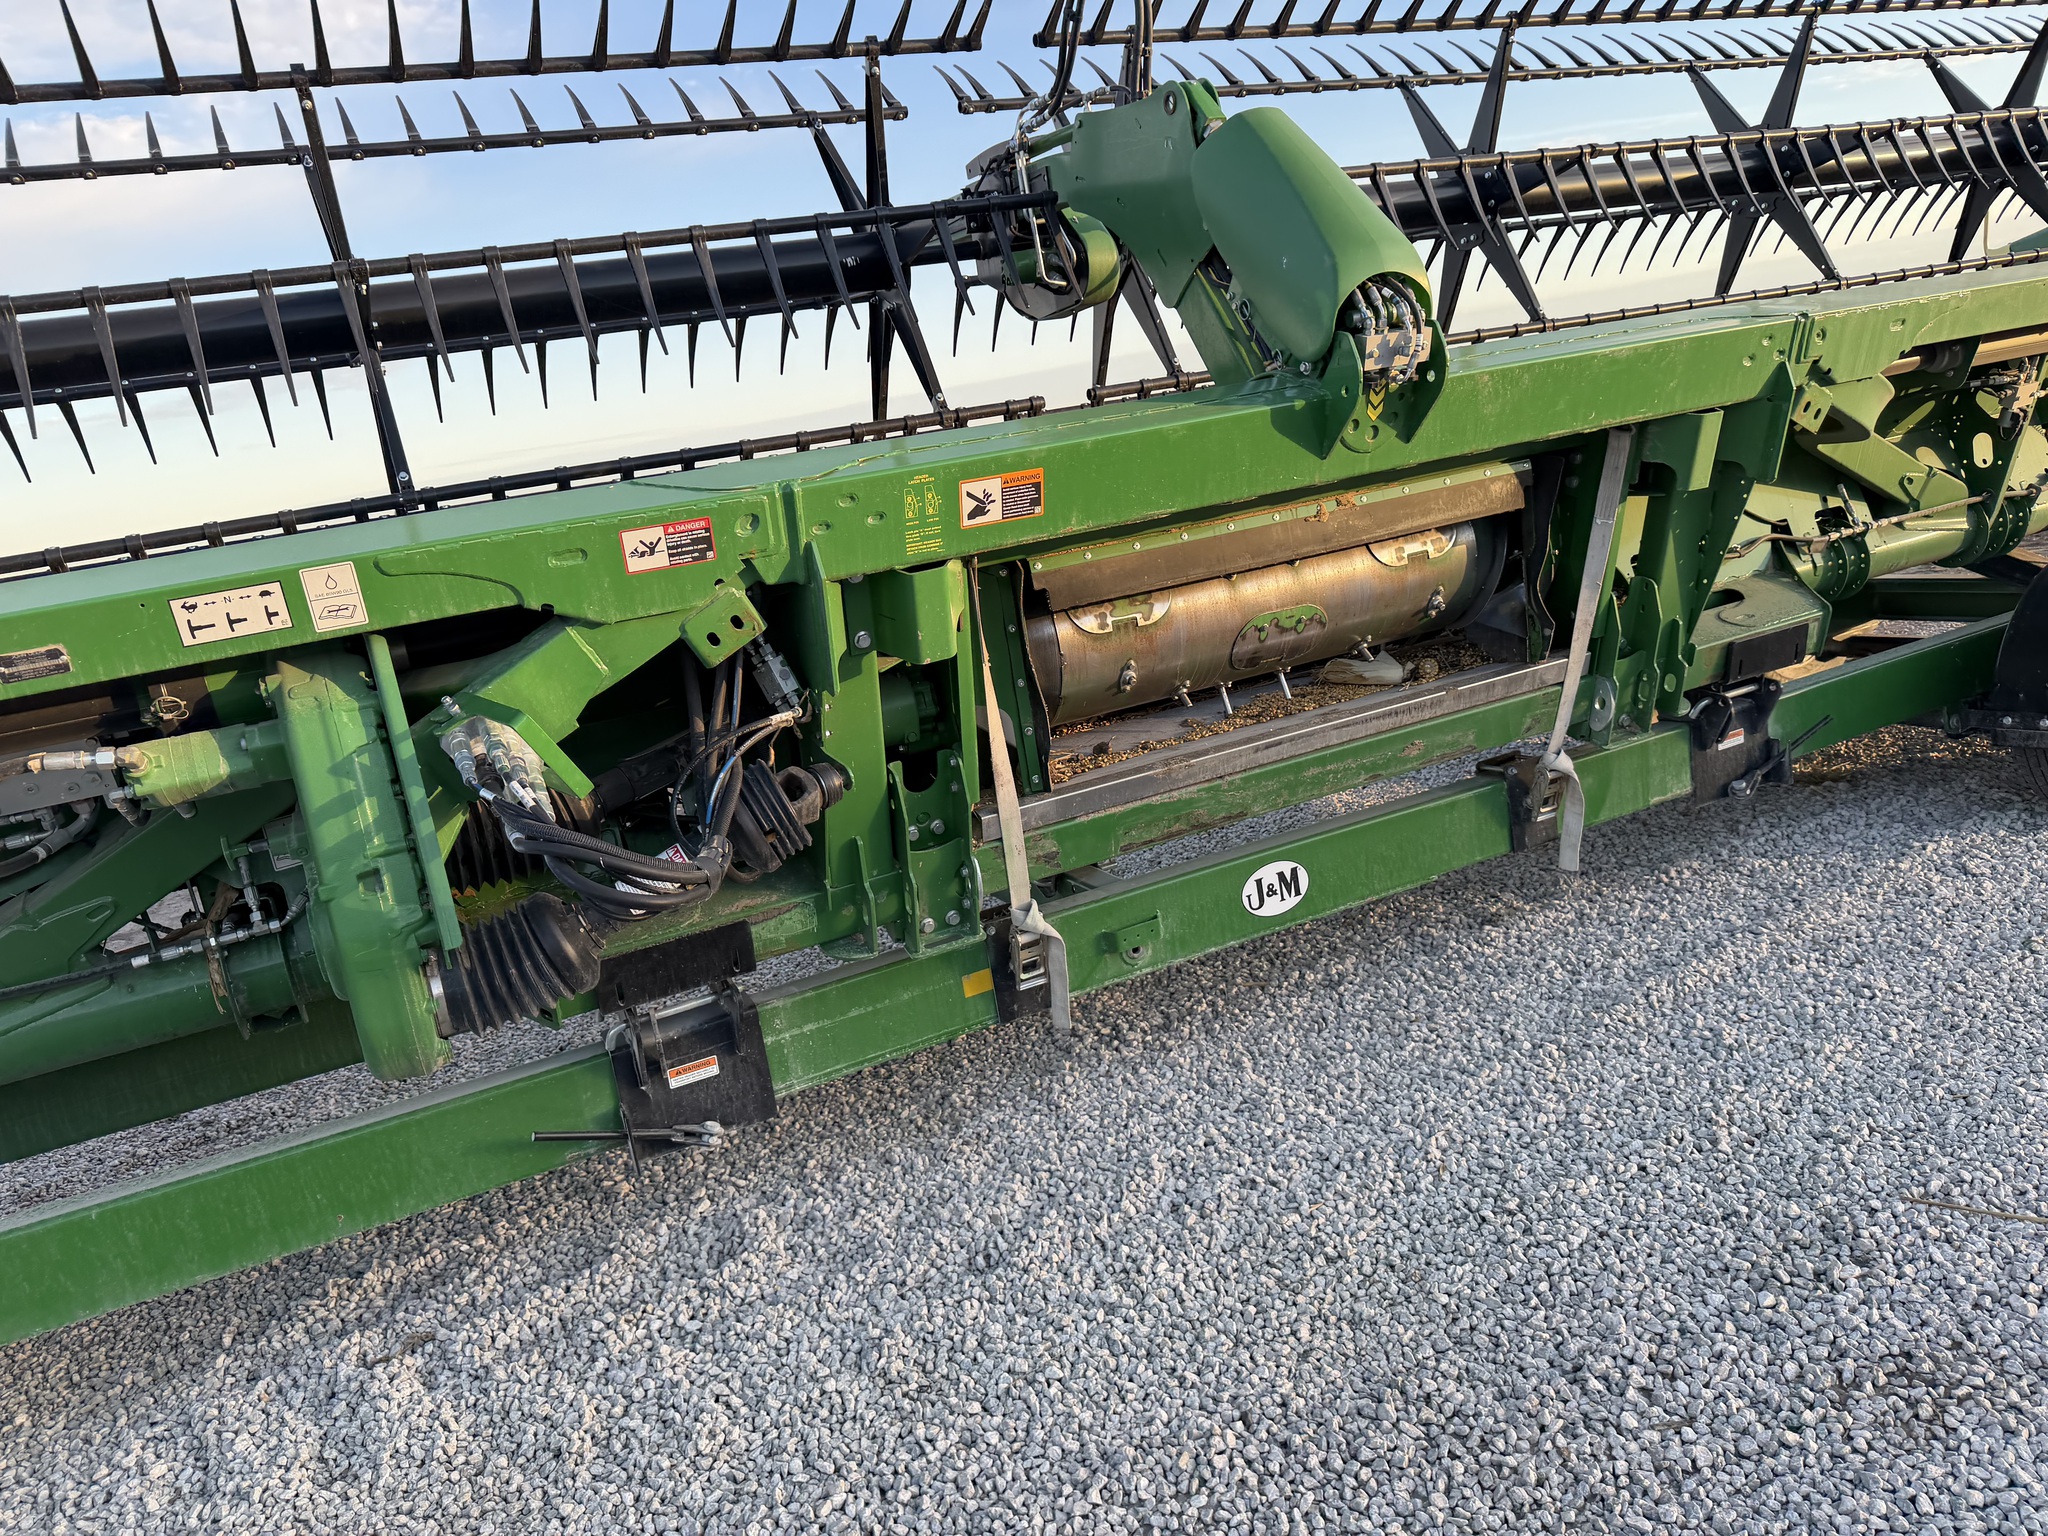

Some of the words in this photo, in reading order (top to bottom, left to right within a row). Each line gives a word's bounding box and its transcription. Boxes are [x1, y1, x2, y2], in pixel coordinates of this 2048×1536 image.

[1009, 473, 1041, 484] WARNING
[676, 521, 706, 530] DANGER
[223, 595, 232, 604] N
[1246, 865, 1302, 911] J&M
[682, 1060, 711, 1073] WARNING
